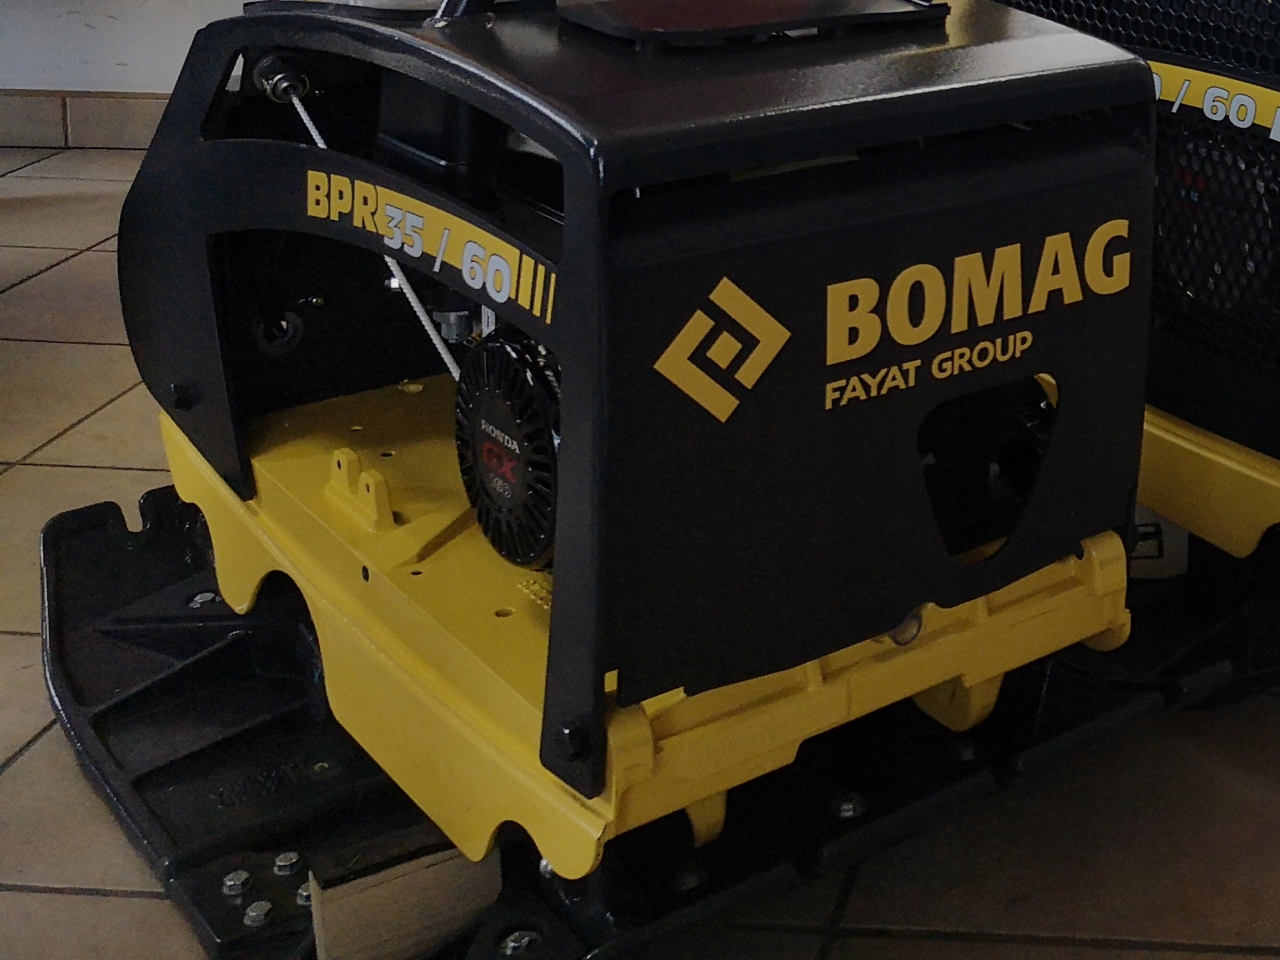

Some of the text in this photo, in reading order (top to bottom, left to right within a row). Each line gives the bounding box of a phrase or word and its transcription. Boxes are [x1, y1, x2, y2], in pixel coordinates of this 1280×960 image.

[1202, 86, 1257, 129] 60
[307, 169, 378, 233] BPR
[383, 203, 425, 258] 35
[462, 240, 512, 304] 60
[825, 218, 1131, 366] BOMAG
[824, 330, 1034, 411] FAYAT GROUP
[481, 419, 521, 454] HONDA
